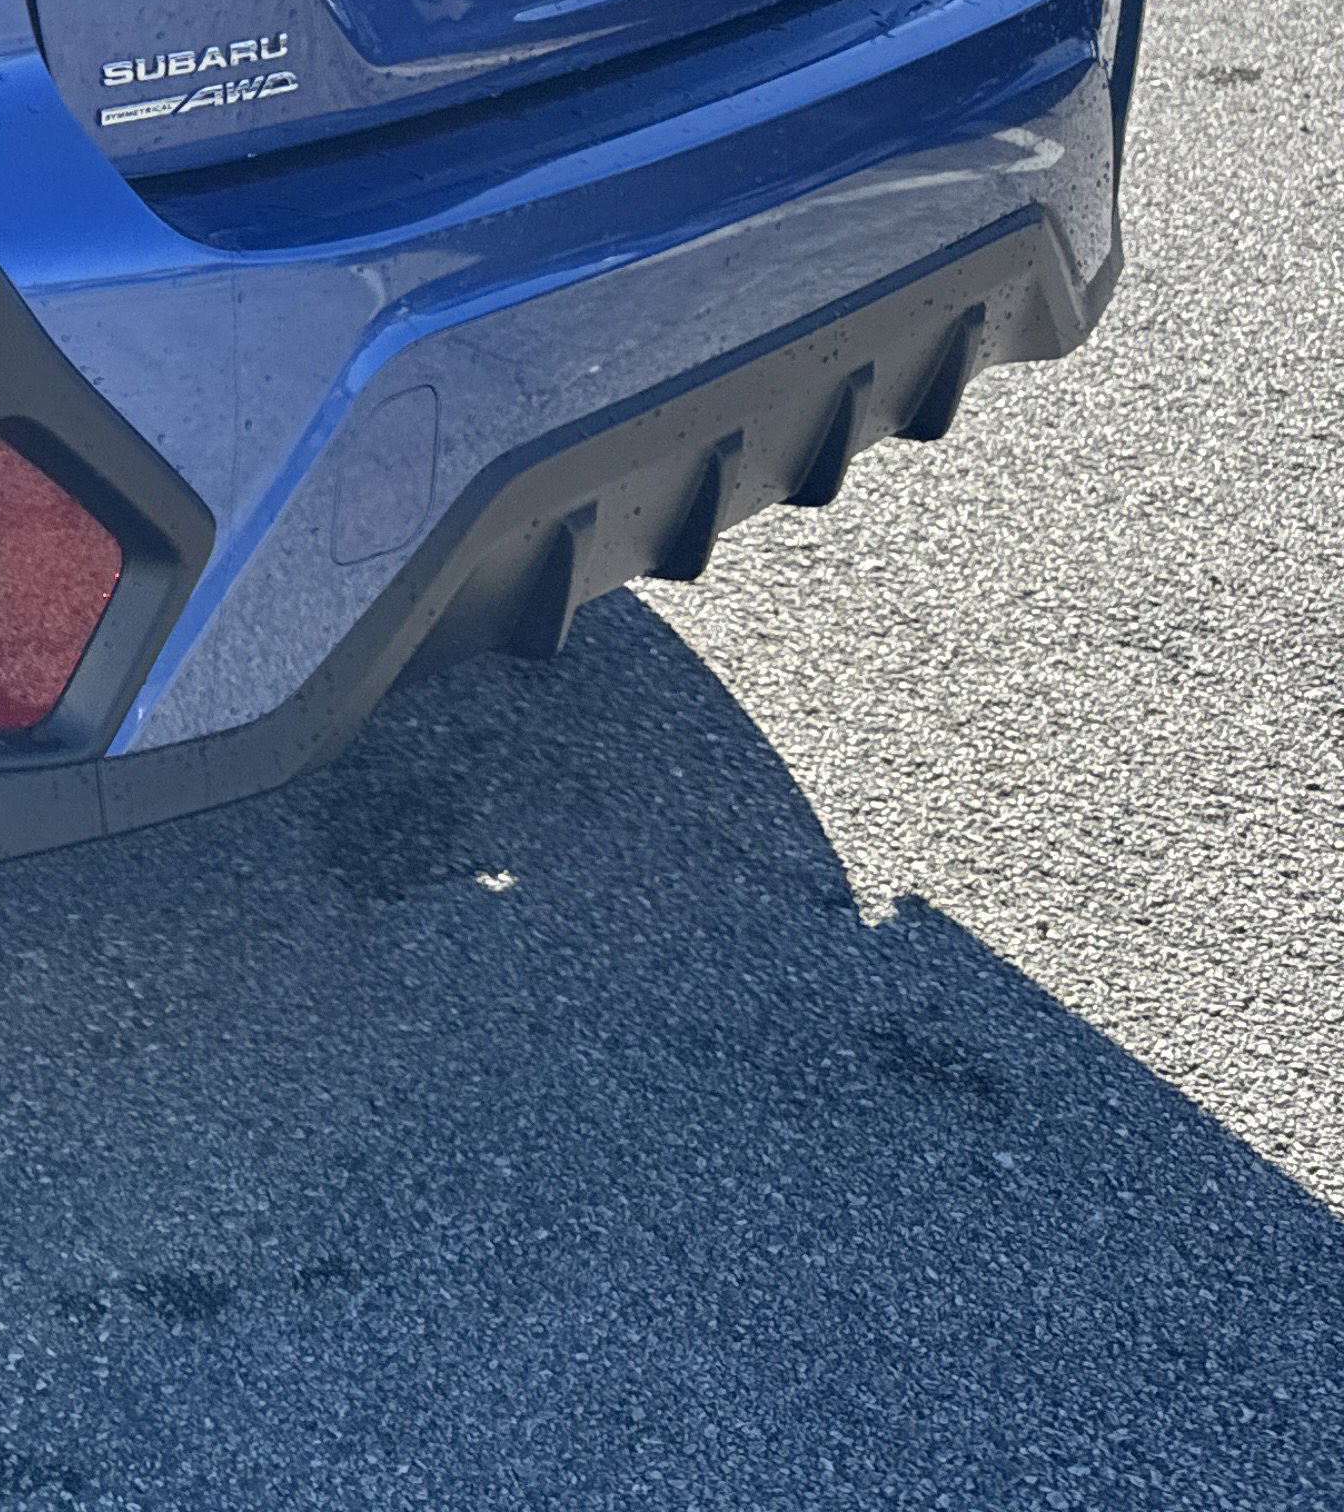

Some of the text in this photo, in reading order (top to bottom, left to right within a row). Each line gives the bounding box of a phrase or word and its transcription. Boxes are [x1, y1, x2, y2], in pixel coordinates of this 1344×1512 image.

[102, 33, 288, 87] SUBARU
[104, 71, 299, 122] SYMMETRICAL AWD
